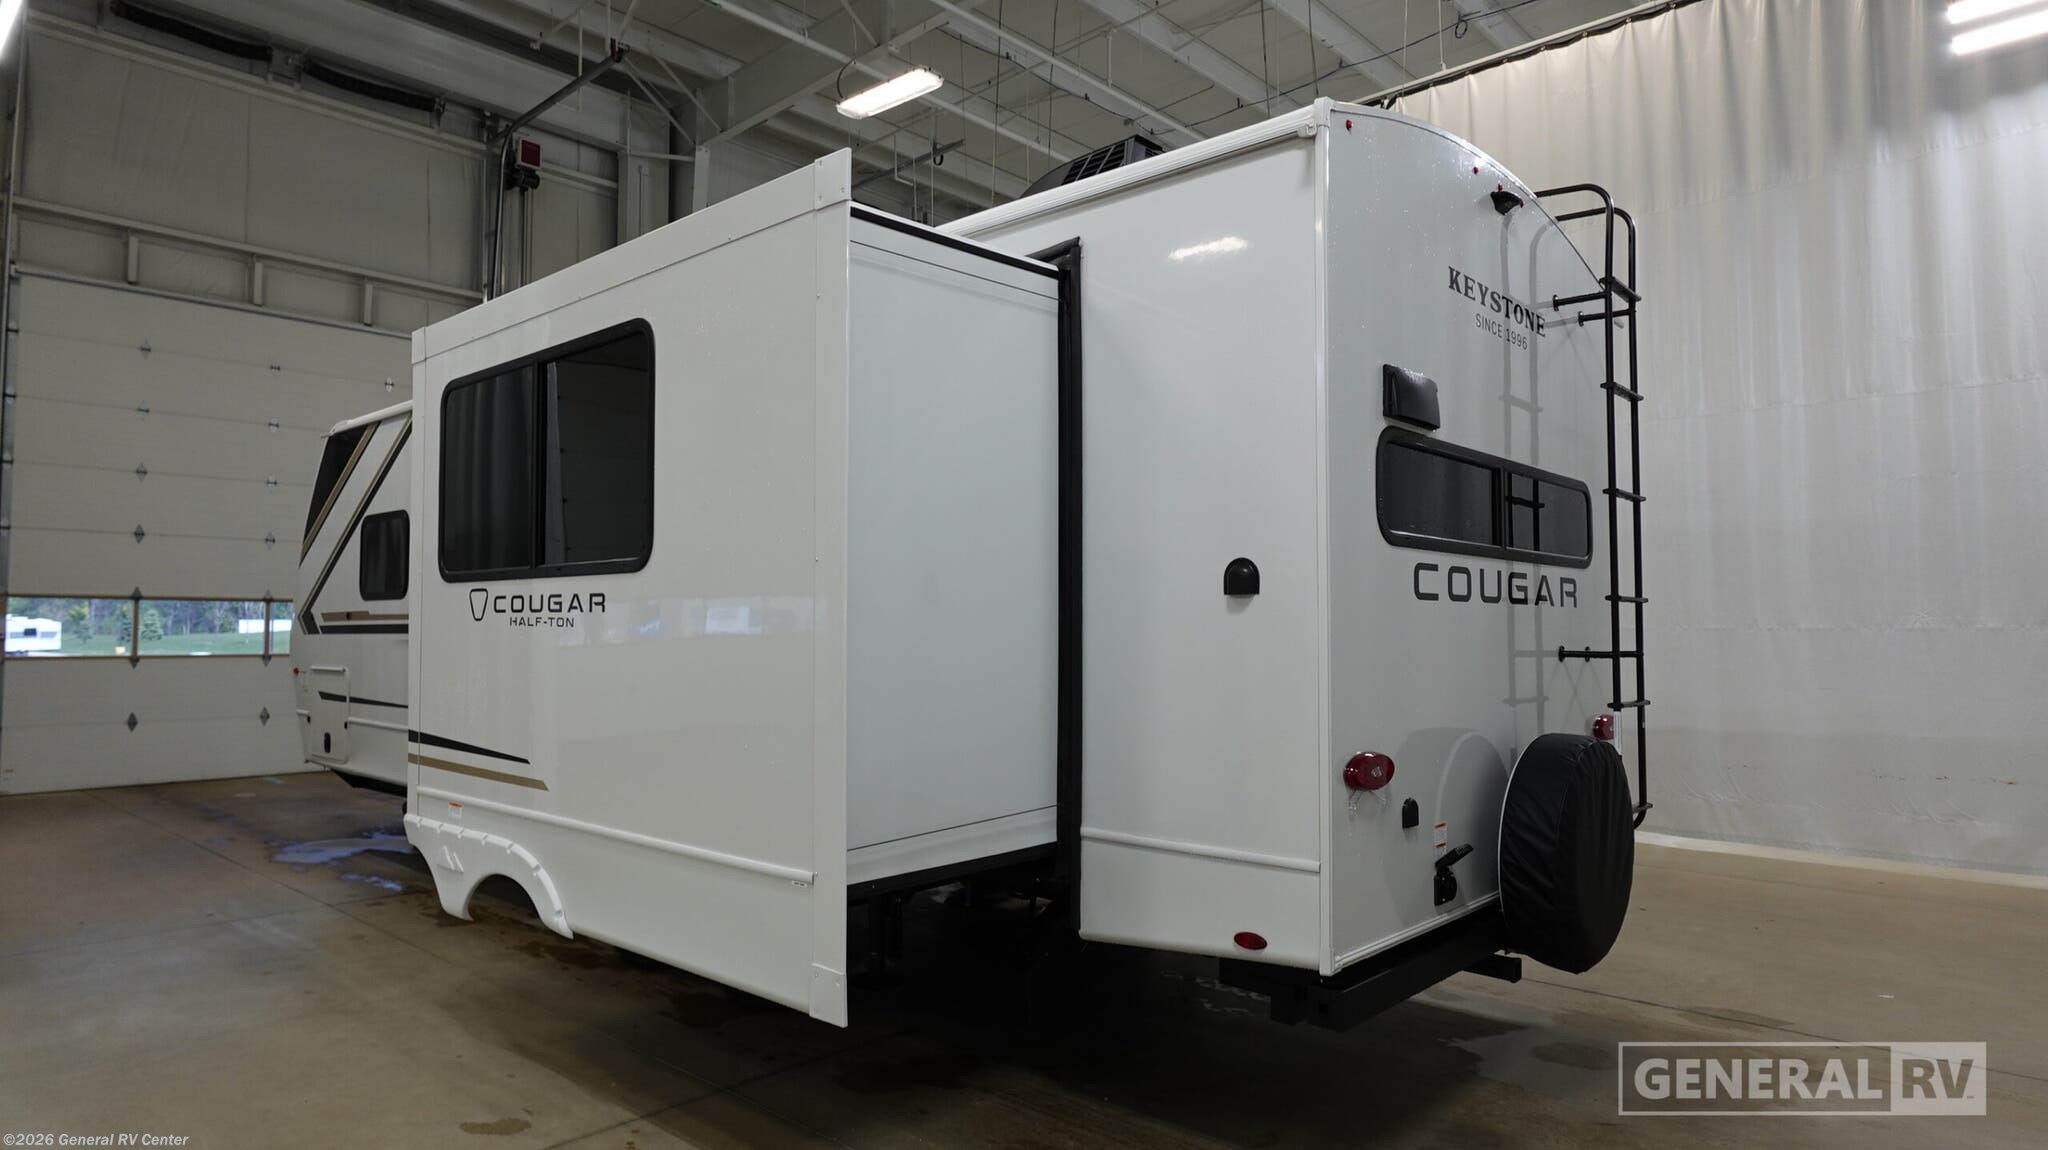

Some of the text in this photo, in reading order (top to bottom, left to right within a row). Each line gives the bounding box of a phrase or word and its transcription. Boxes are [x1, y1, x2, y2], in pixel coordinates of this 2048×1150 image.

[1448, 265, 1547, 338] KEYSTONE
[1475, 312, 1528, 351] SINCE 1996
[493, 592, 606, 613] COUGAR
[1413, 562, 1578, 608] COUGAR
[509, 616, 575, 628] HALF-TON
